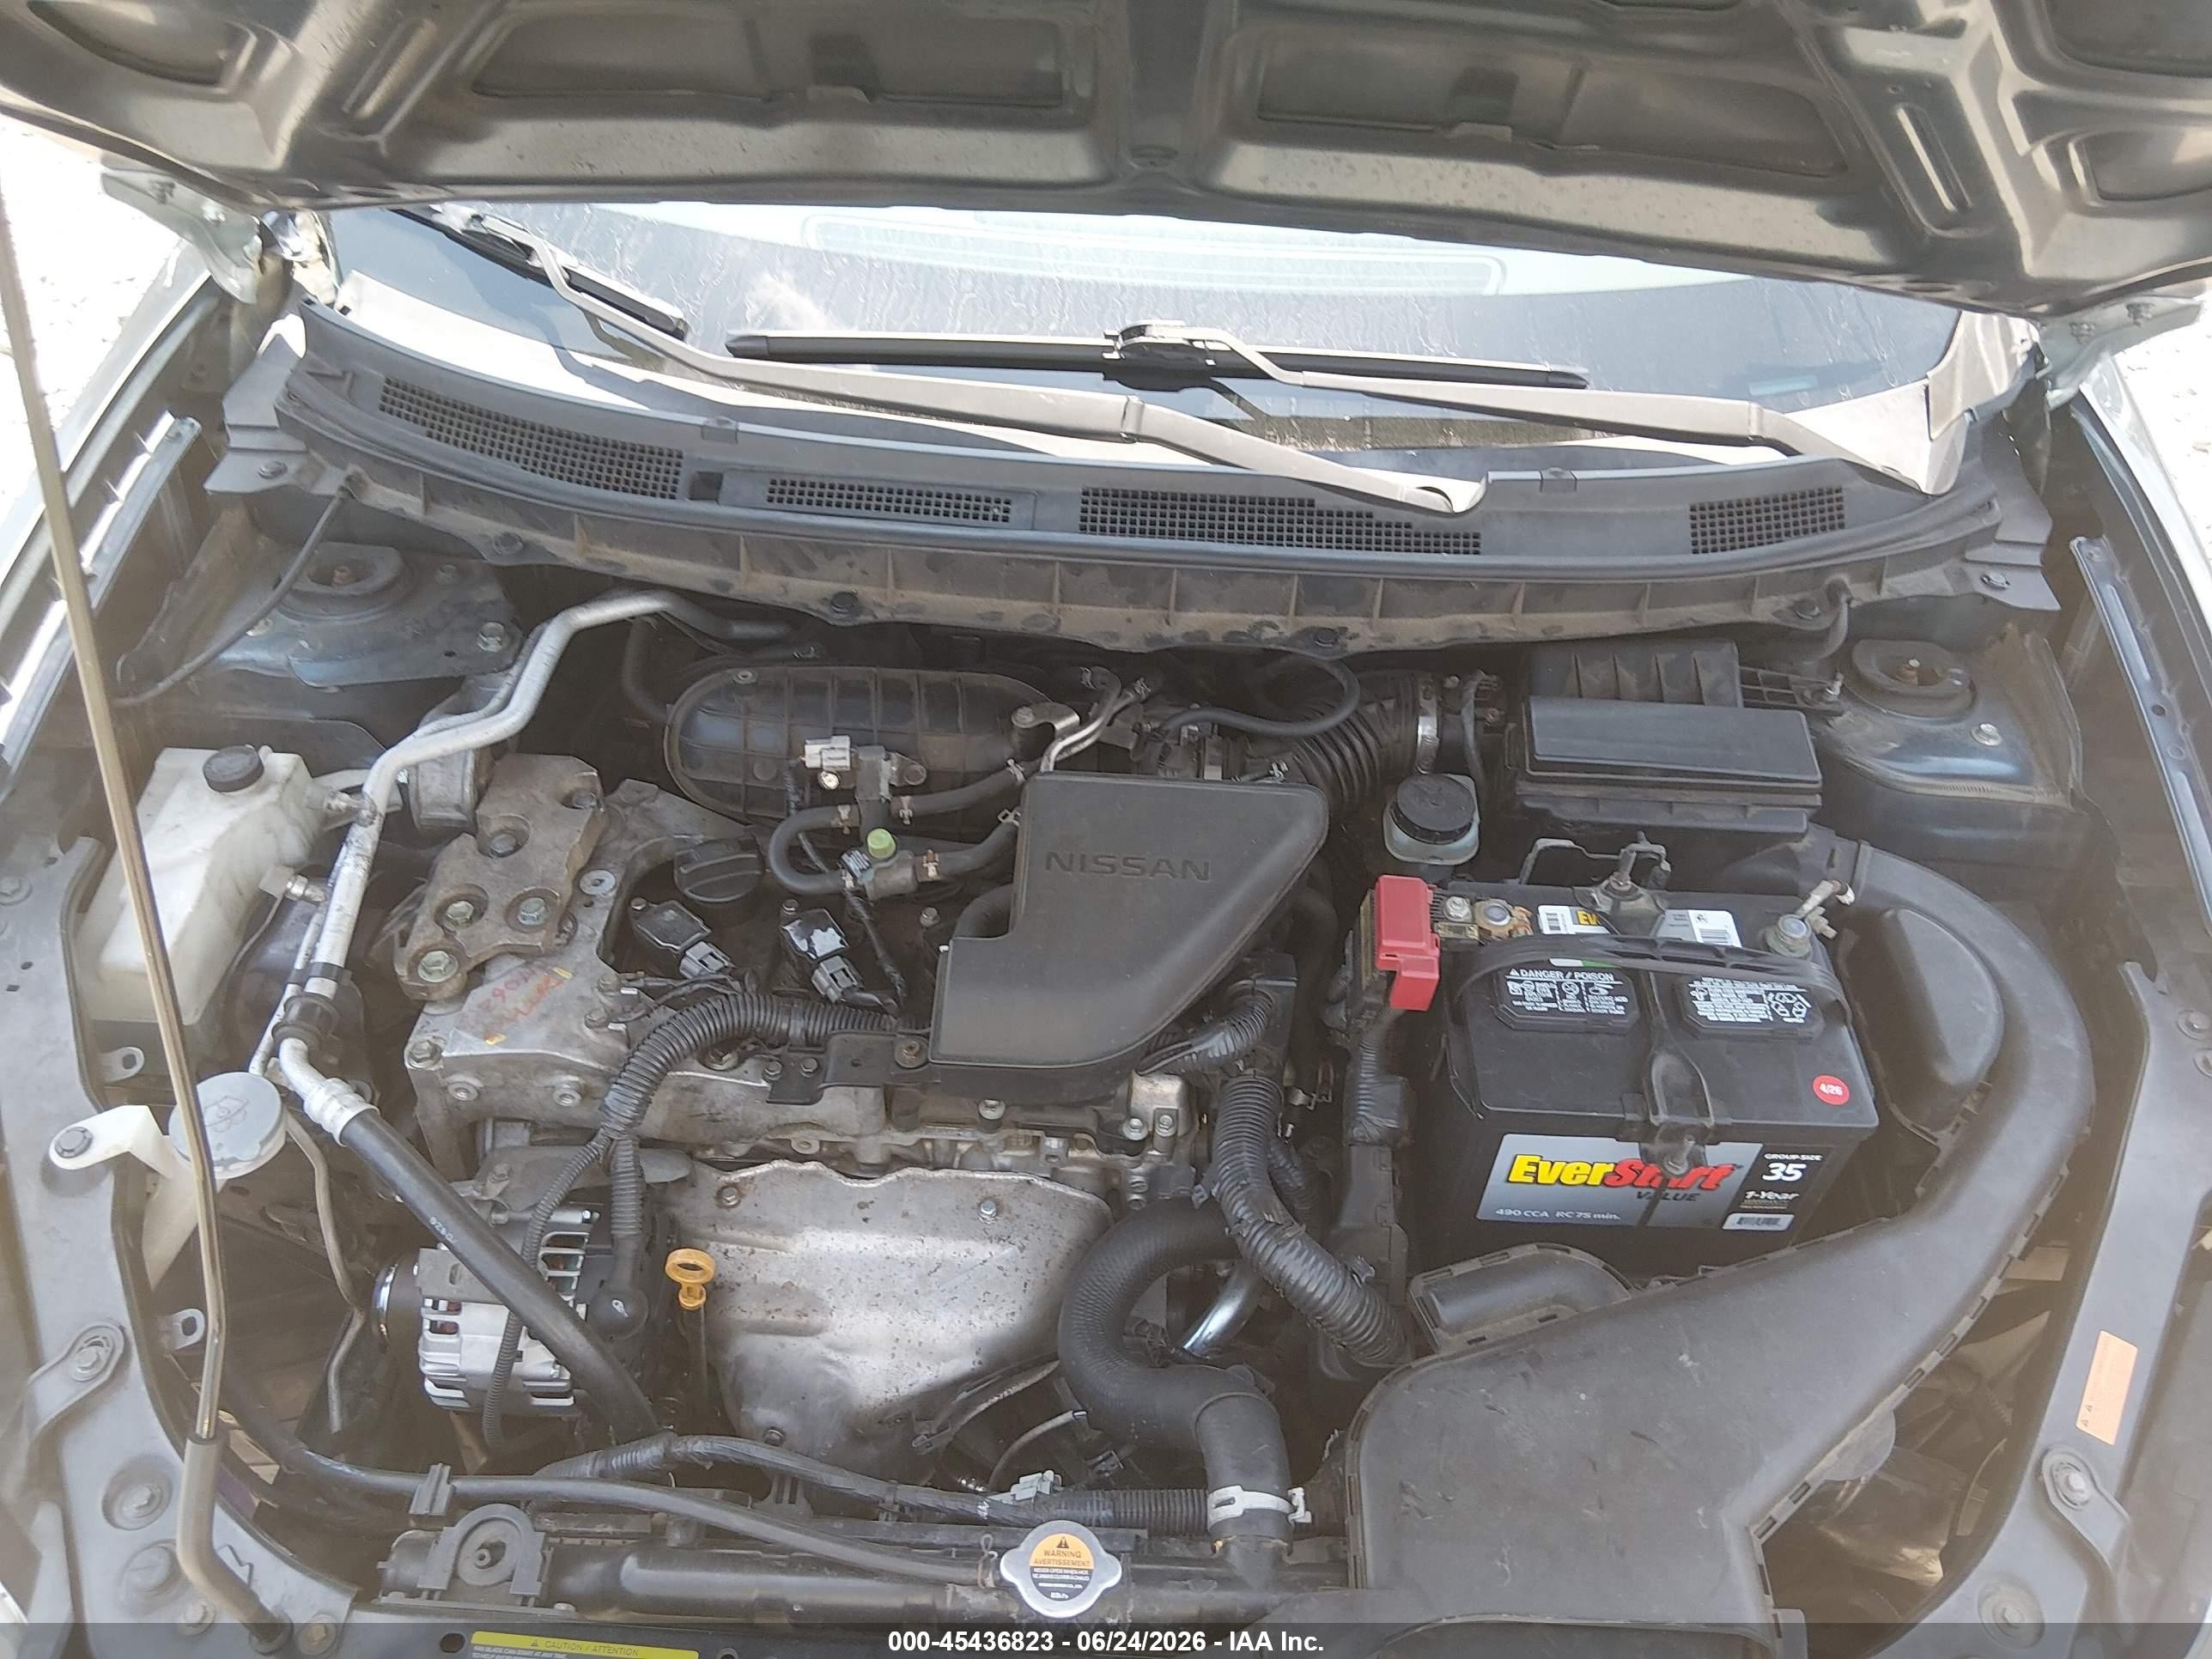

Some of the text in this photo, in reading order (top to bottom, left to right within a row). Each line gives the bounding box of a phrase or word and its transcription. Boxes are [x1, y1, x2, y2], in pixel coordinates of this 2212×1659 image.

[1044, 850, 1210, 882] NISSAN
[1520, 969, 1565, 980] DANGER
[1574, 971, 1614, 981] POISON
[1762, 1162, 1807, 1181] 35
[1637, 1191, 1700, 1201] VLUE
[1495, 1208, 1522, 1217] 490
[1043, 1549, 1082, 1559] WARNING
[1033, 1558, 1091, 1567] AVERTISSEMENT
[544, 1640, 583, 1651] CAUTION
[592, 1645, 639, 1656] ATTENTION
